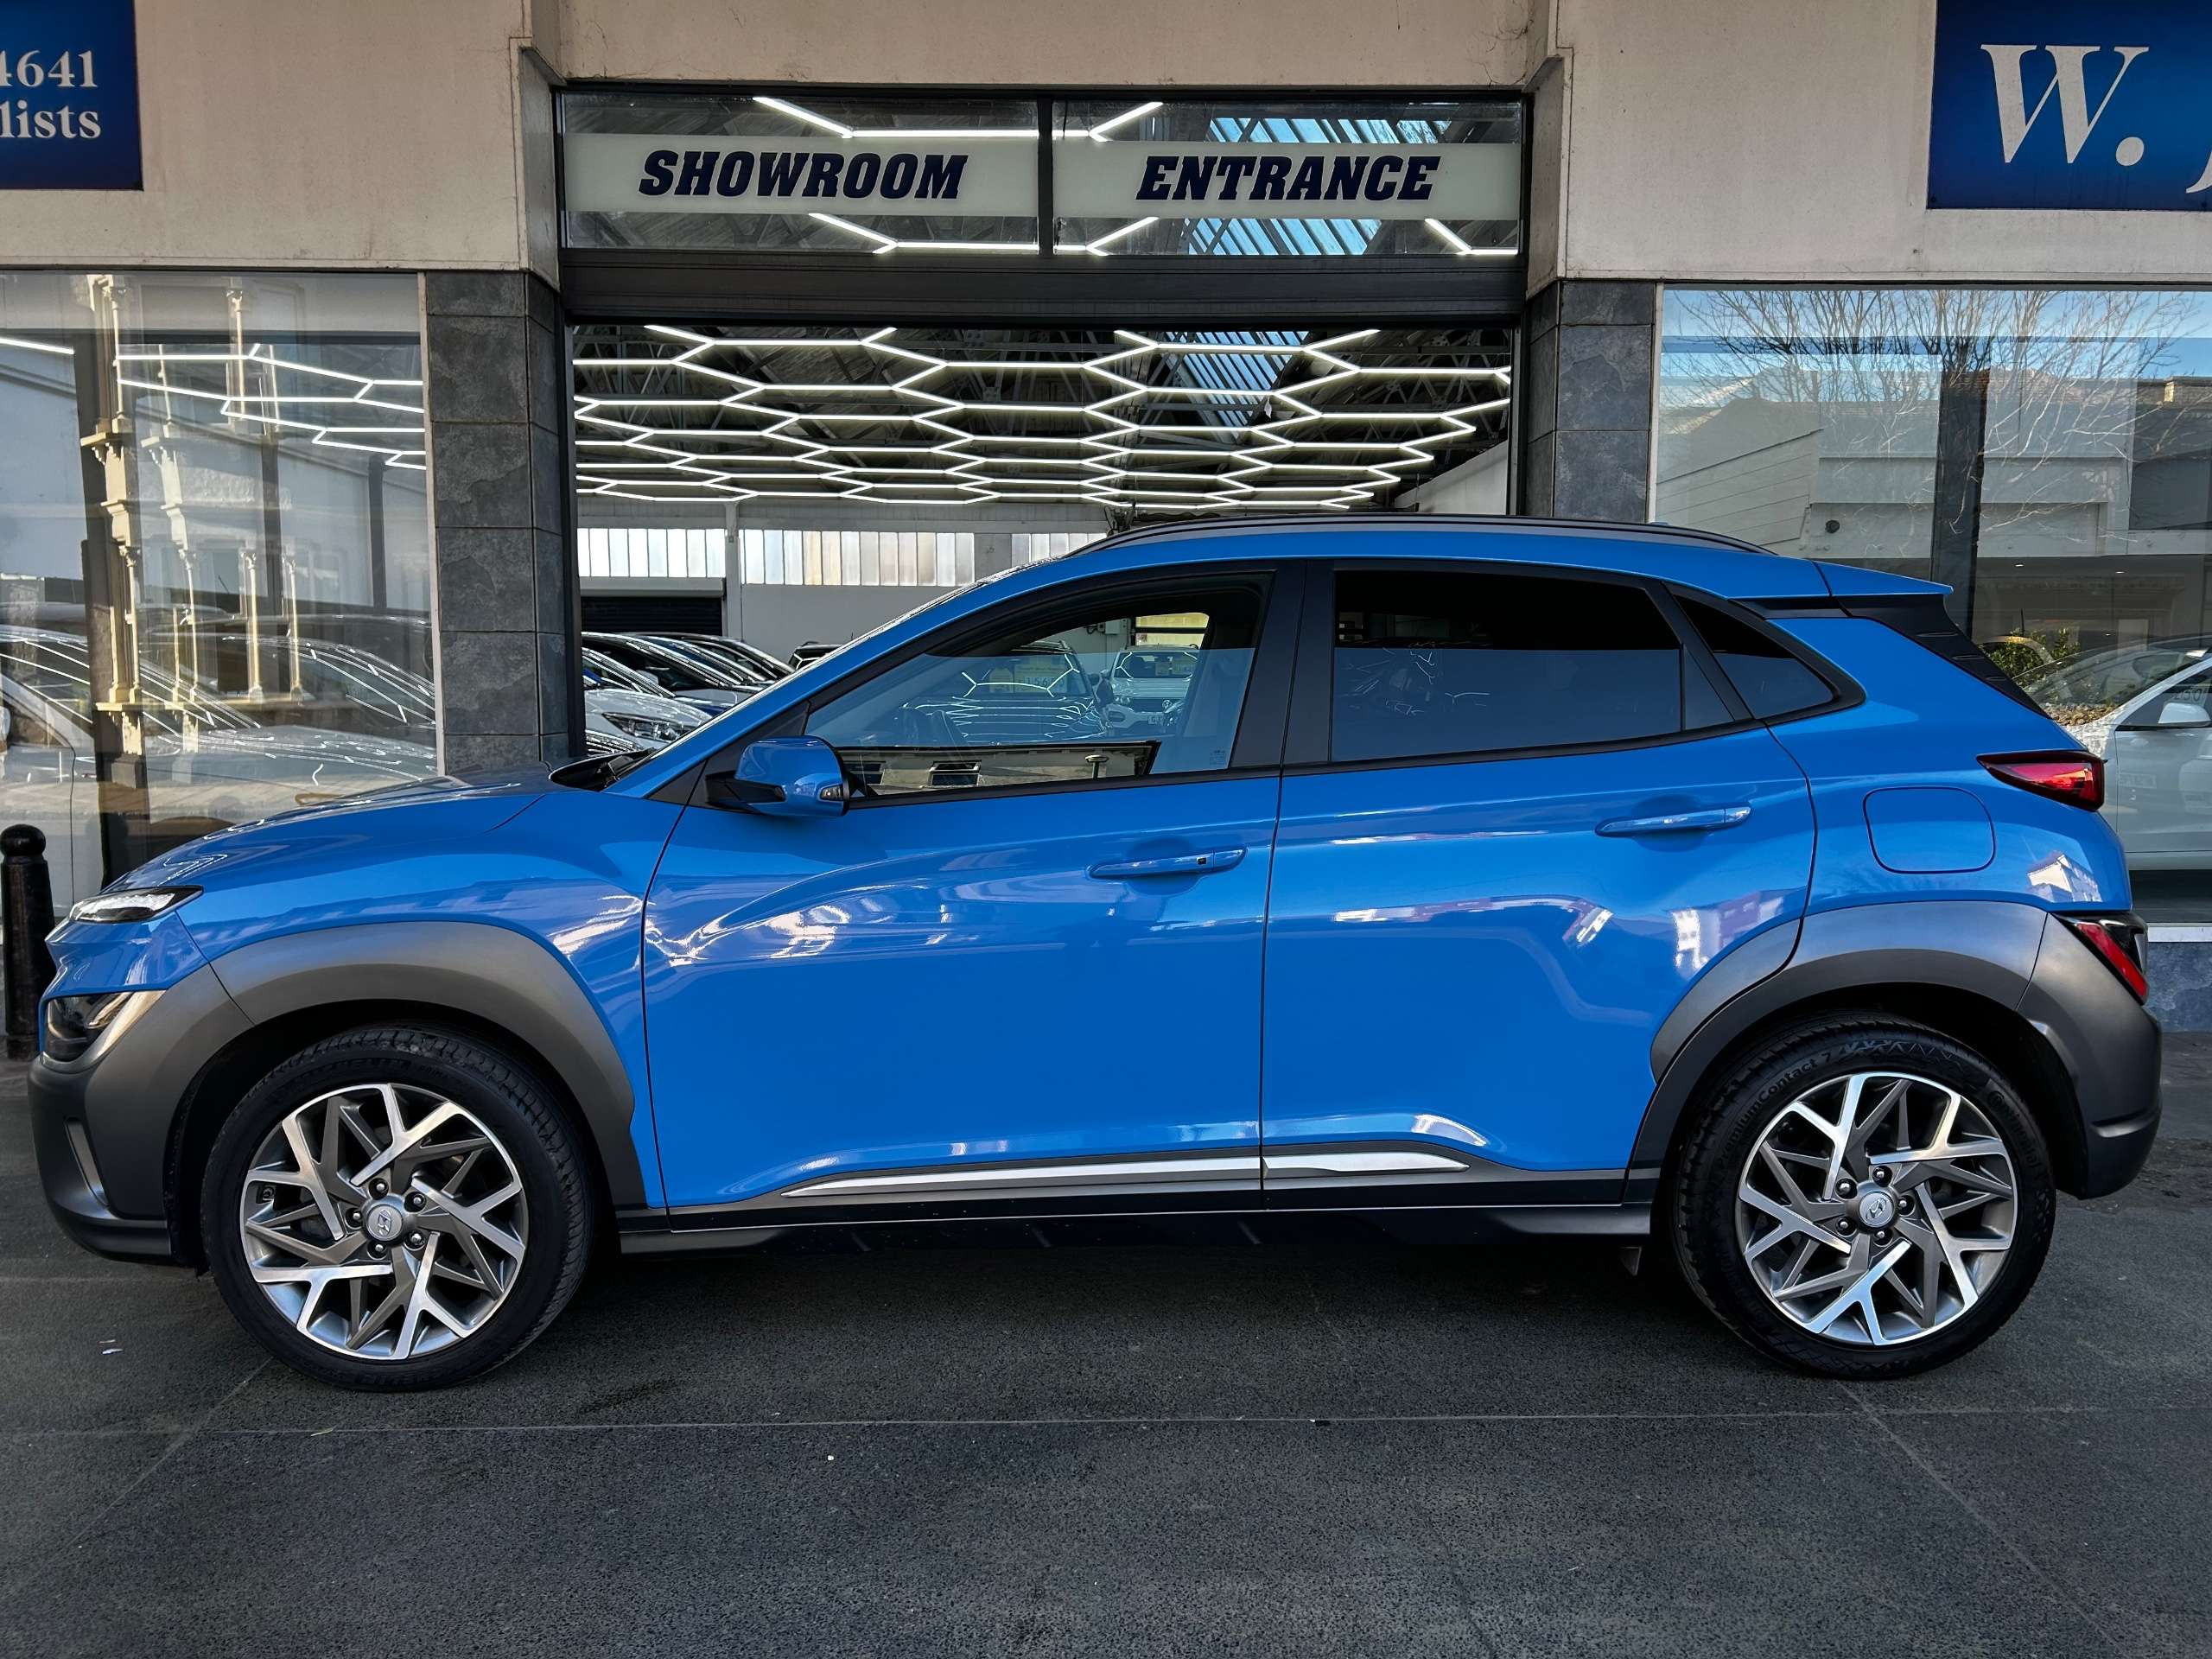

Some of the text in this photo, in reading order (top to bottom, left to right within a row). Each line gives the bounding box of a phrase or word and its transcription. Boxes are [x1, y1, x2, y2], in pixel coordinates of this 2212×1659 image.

[1980, 44, 2148, 166] W.
[639, 149, 1441, 201] SHOWROOM ENTRANCE
